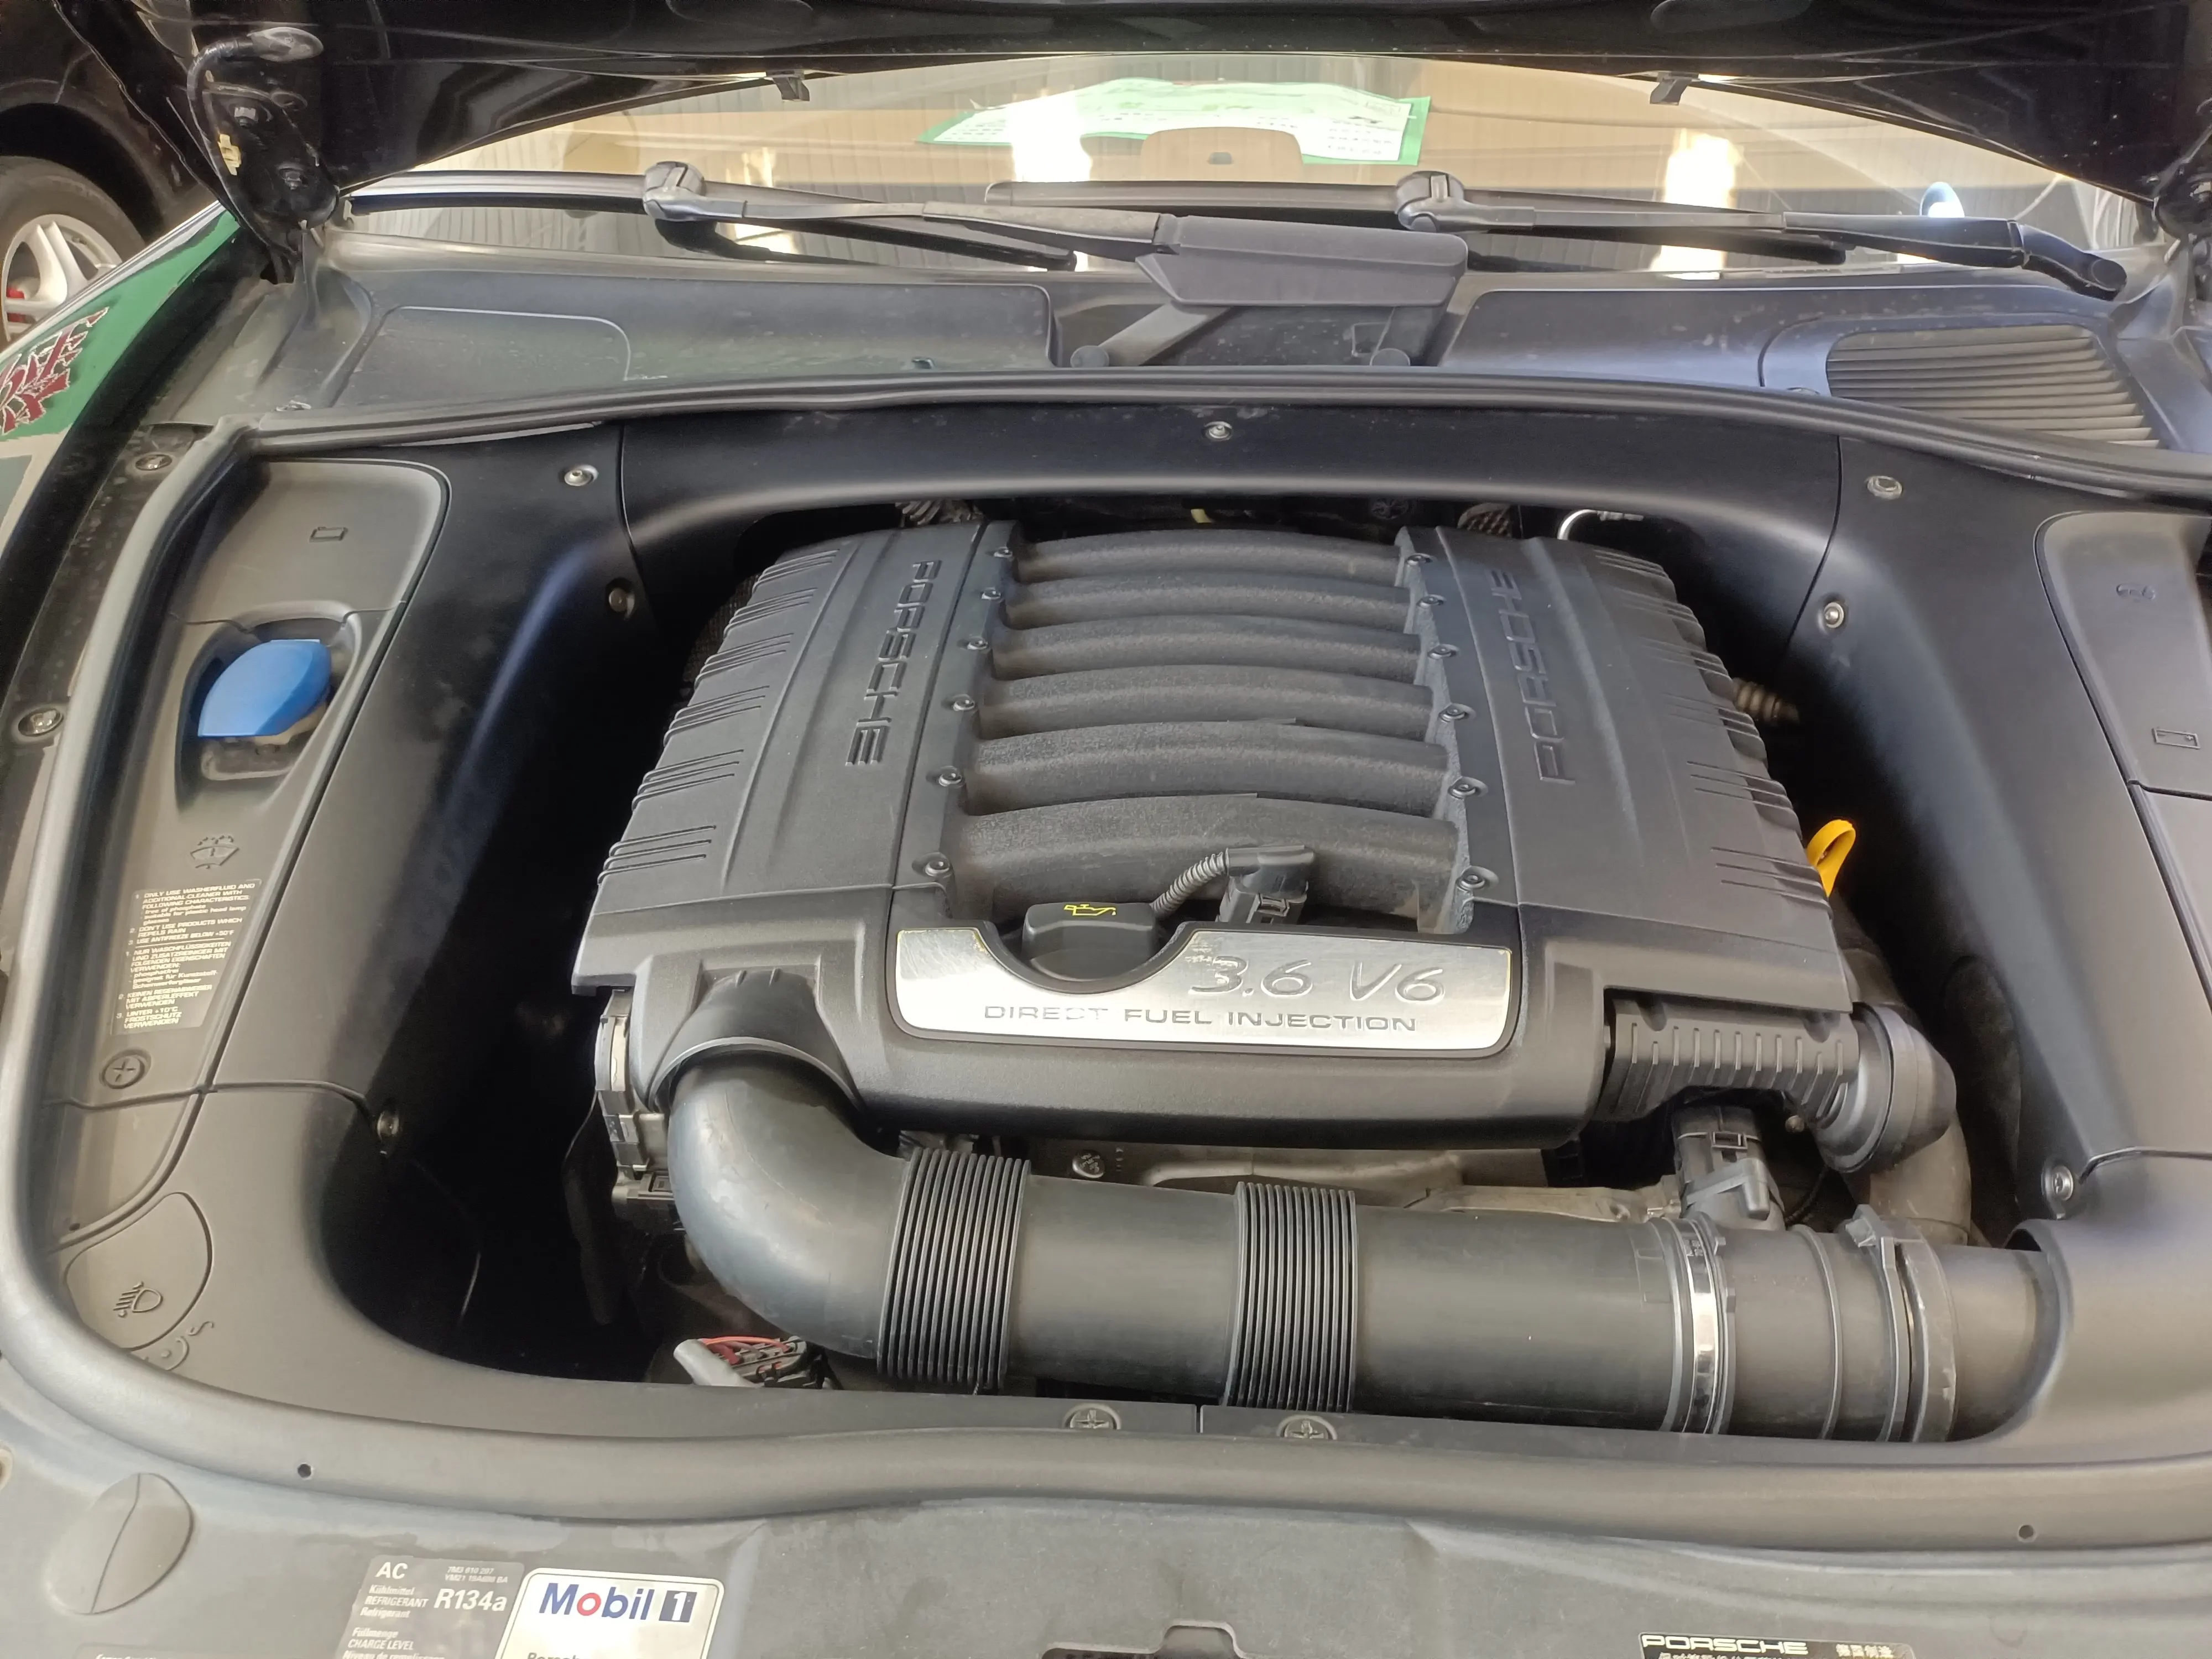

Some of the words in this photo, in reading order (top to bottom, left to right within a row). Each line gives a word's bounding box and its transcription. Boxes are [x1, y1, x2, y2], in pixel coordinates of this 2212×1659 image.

[845, 560, 942, 766] PORSCHE
[1484, 568, 1575, 785] PORSCHE
[182, 884, 237, 894] WASHERFLUID
[142, 900, 184, 910] FOLLOWING
[177, 919, 216, 927] PRODUCTS
[138, 930, 166, 938] REPELS
[150, 933, 189, 942] ANTIFREEZE
[150, 948, 212, 959] ZUSATZREINIGER
[131, 958, 170, 967] FOLGENDEN
[171, 953, 226, 962] EIGENSCHAFTEN
[1188, 955, 1313, 998] 3.6
[1349, 960, 1446, 1004] V6
[126, 999, 175, 1010] VERWENDEN
[124, 1012, 182, 1023] FROSTSCHUTZ
[126, 1009, 153, 1017] UNTER
[984, 1005, 1109, 1021] DIRECT
[1124, 1009, 1213, 1025] FUEL
[1228, 1011, 1417, 1031] INJECTION
[123, 1018, 179, 1029] VERWENDEN
[375, 1562, 408, 1579] AC
[369, 1584, 415, 1595] Kühlmittel
[364, 1595, 429, 1608] REFRIGERANT
[434, 1588, 508, 1612] R134a
[539, 1582, 655, 1620] Mobil
[359, 1606, 411, 1619] Refrigerant
[352, 1627, 399, 1640] Füllmenge
[348, 1639, 387, 1650] CHARGE
[387, 1640, 414, 1650] LEVEL
[1641, 1635, 1809, 1655] PORSCHE
